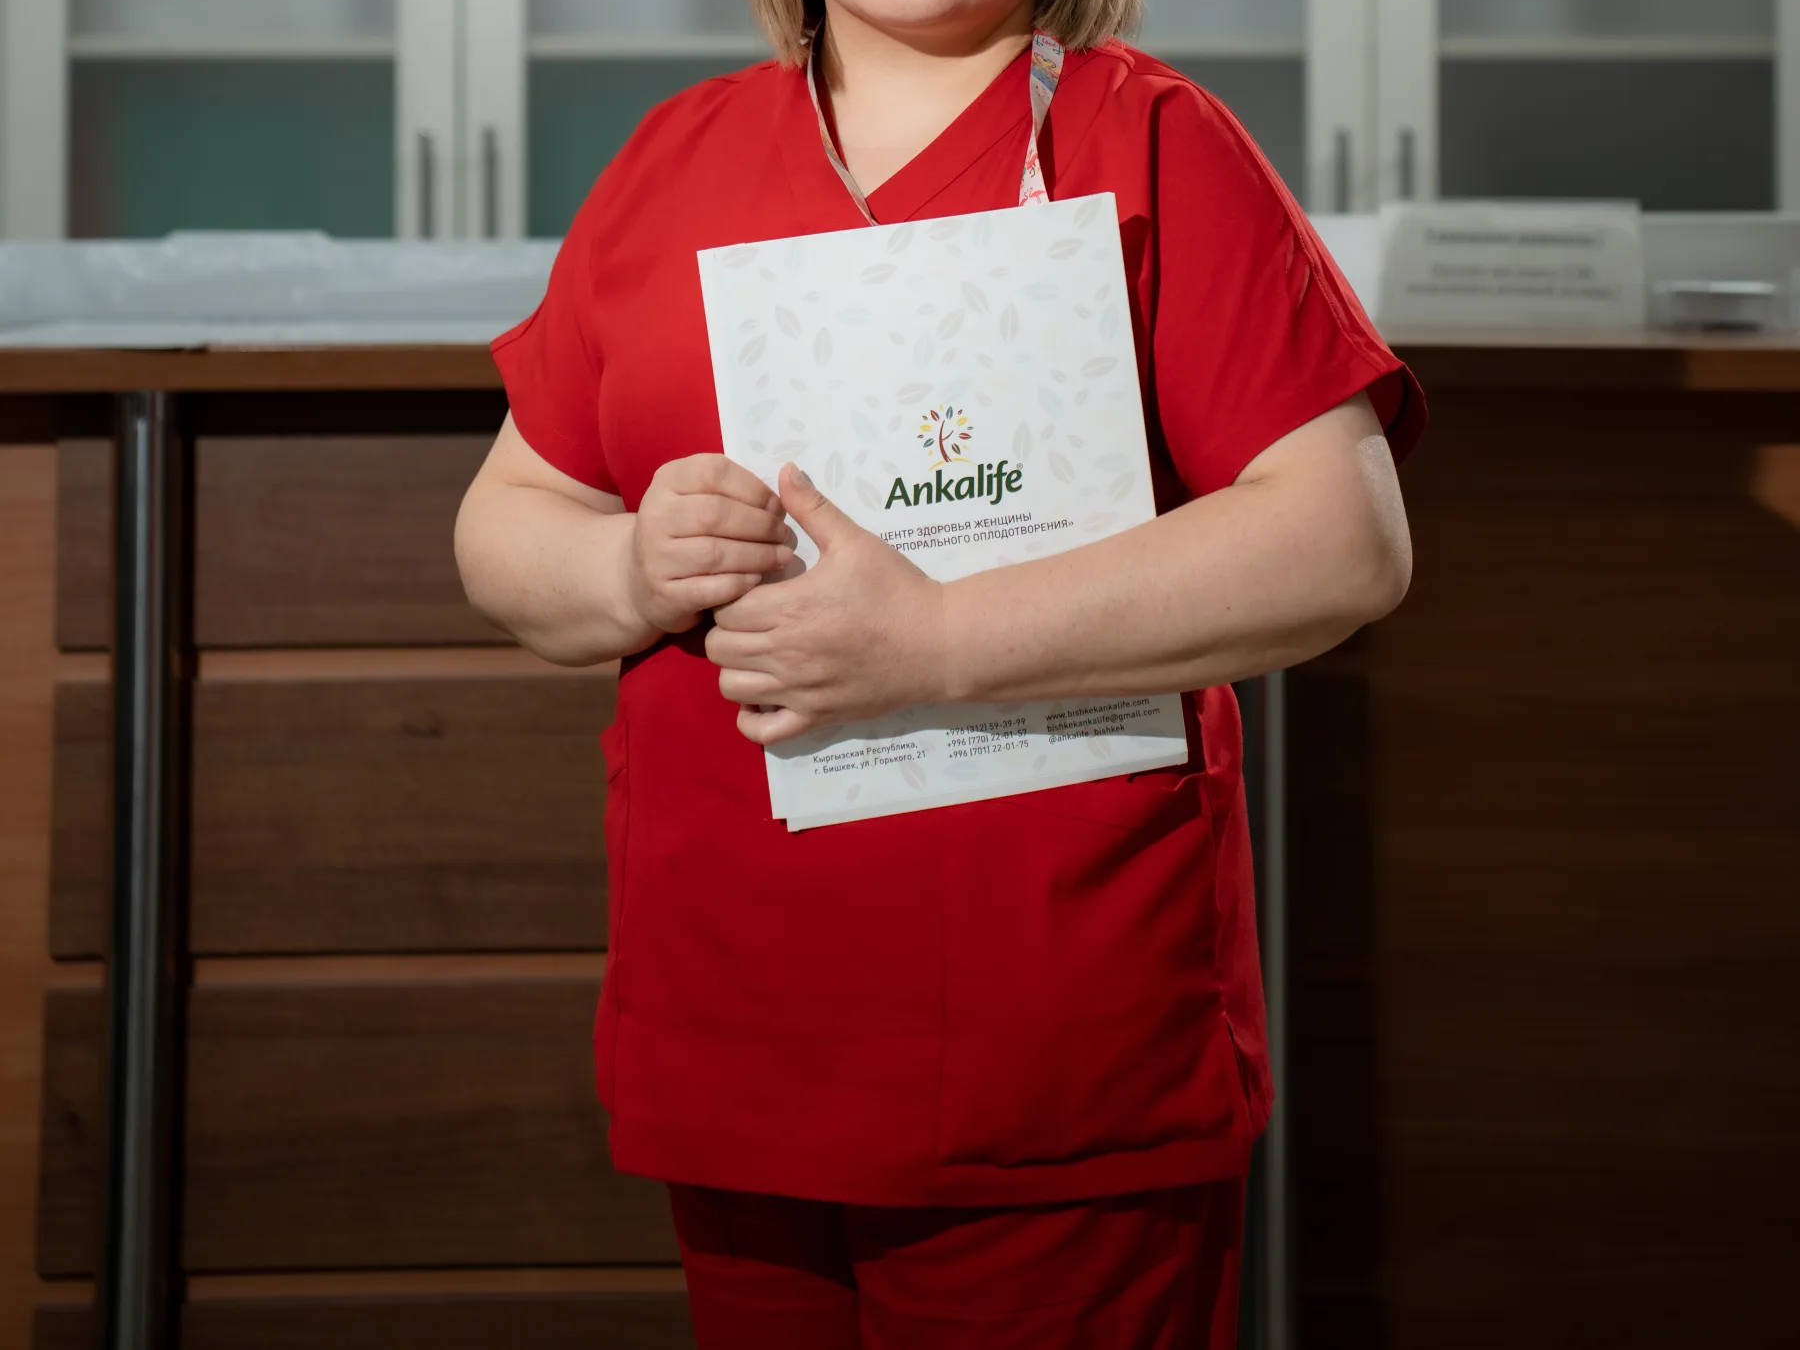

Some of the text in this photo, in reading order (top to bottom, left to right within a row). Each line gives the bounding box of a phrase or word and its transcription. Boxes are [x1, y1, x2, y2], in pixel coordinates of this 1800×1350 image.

[884, 460, 1023, 510] Ankalife
[880, 512, 1032, 542] ЦЕНТР ЗДОРОВЬЯ ЖЕНЩИНЫ
[973, 519, 1074, 543] ОПЛОДОТВОРЕНИЯ»
[1045, 698, 1150, 722] www.bishkekankalife.com
[1047, 707, 1161, 733] bishkekankalife@gmail.com
[946, 717, 1026, 736] +996 (312) 59-39-99
[947, 728, 1027, 748] +996 (770) 22-01-57
[813, 741, 918, 765] Кыргызская Республика,
[949, 739, 1029, 759] +996 (701) 22-01-75
[823, 763, 858, 774] Бишкек,
[860, 760, 872, 770] ул.
[874, 753, 915, 767] Горького,
[917, 750, 926, 759] 21
